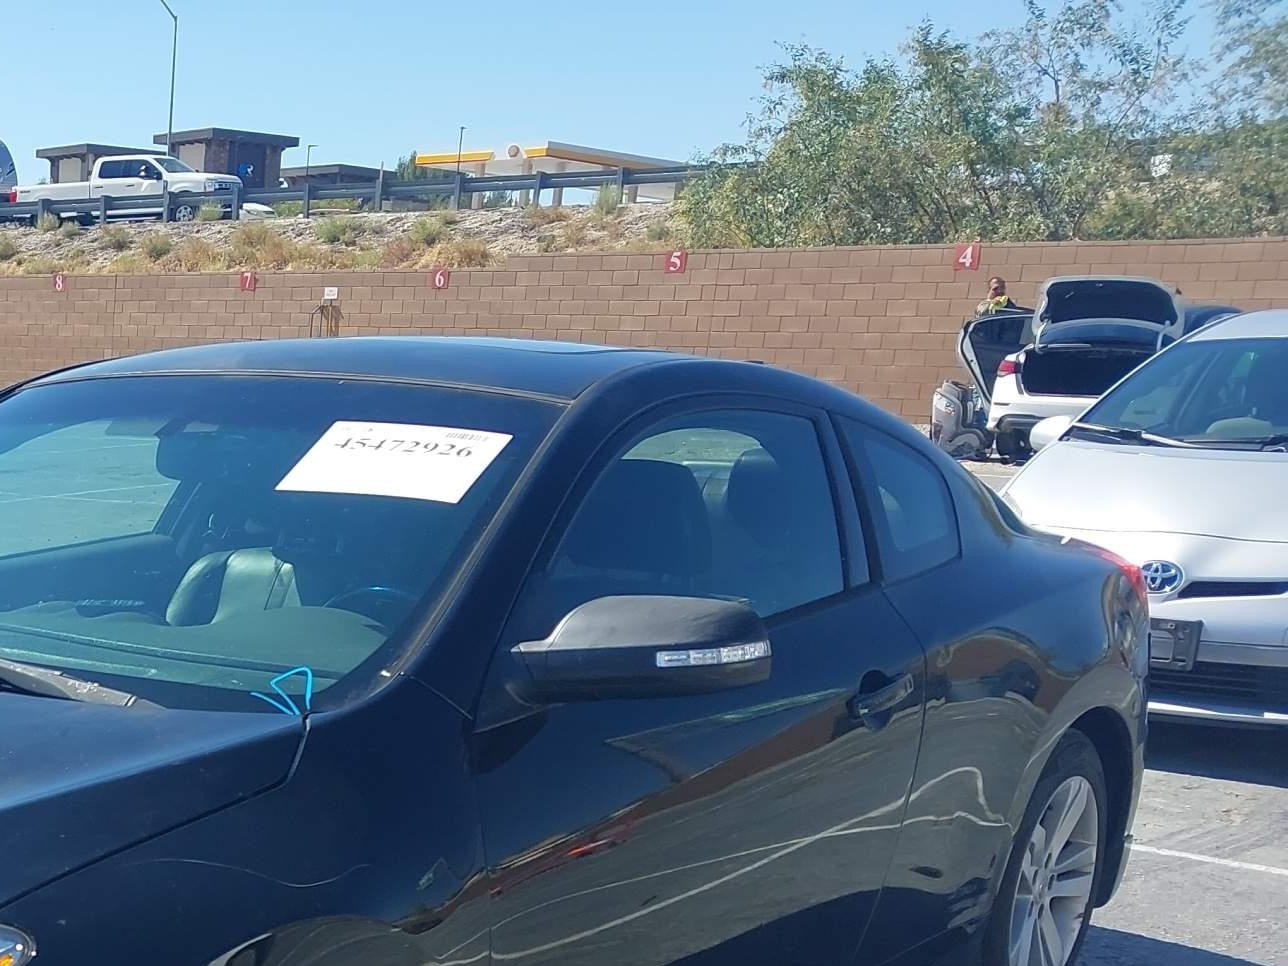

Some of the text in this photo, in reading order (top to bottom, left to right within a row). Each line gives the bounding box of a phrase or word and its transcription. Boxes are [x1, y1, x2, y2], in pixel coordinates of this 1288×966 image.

[669, 251, 682, 271] 5
[958, 245, 972, 267] 4
[55, 275, 63, 291] 8
[243, 272, 252, 288] 7
[435, 270, 444, 287] 6
[334, 437, 473, 458] 45472926
